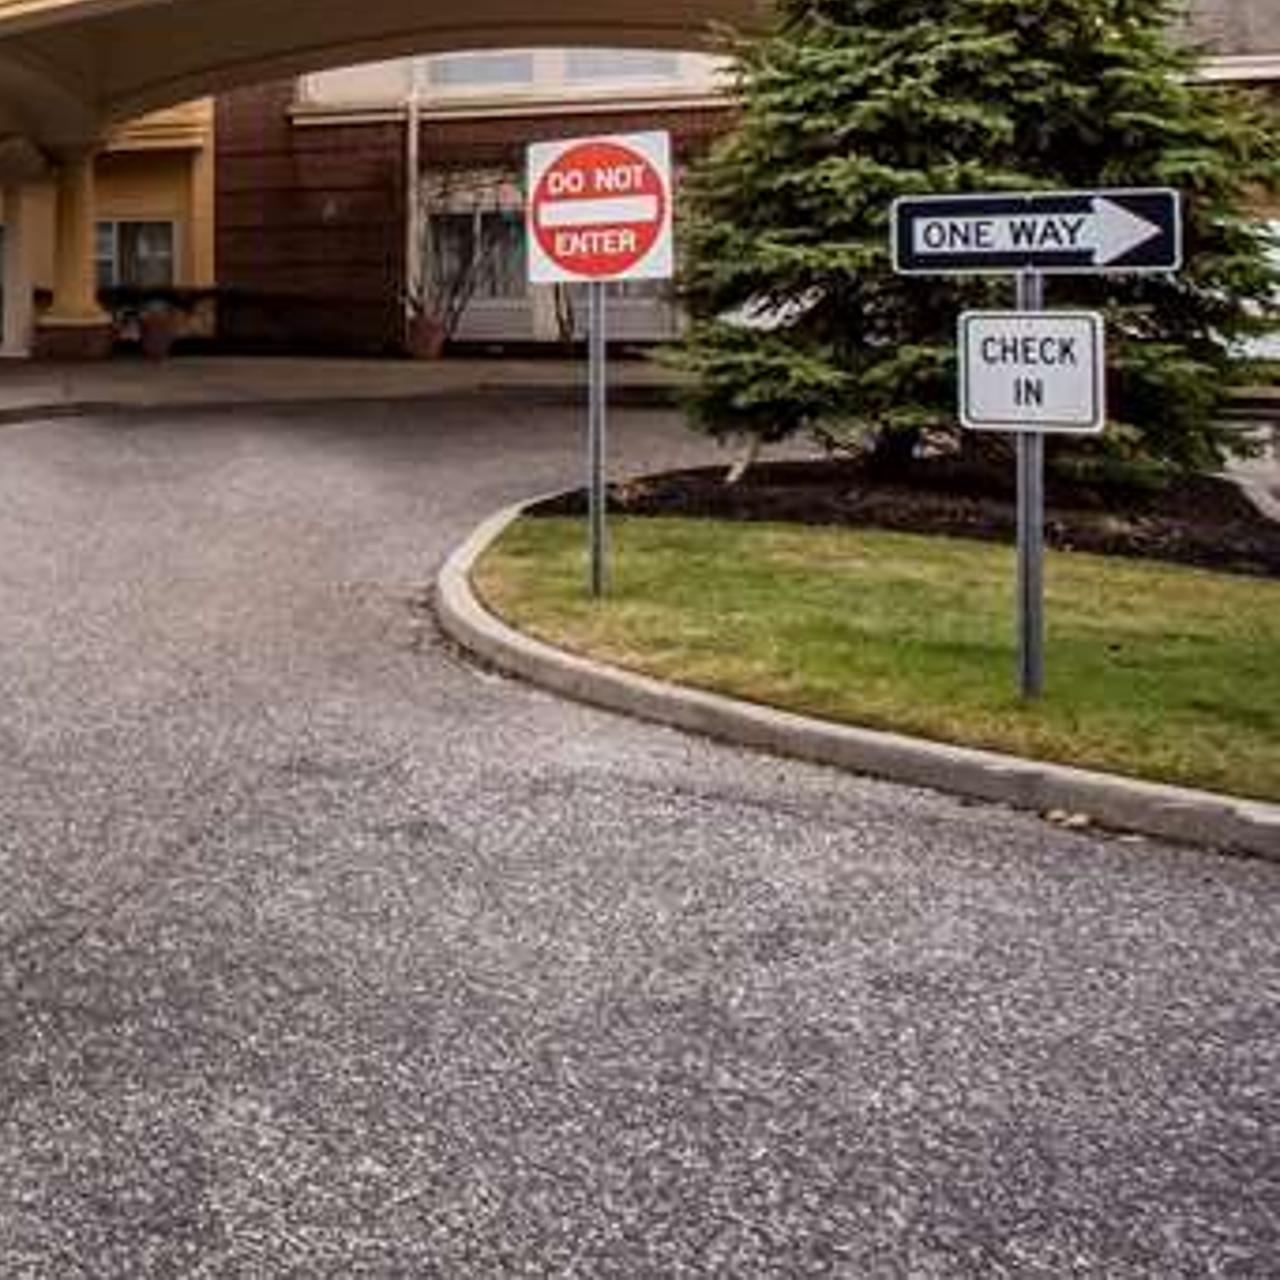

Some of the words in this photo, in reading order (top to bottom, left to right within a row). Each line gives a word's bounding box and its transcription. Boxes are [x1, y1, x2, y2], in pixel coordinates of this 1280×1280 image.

[547, 169, 585, 194] DO
[595, 164, 647, 191] NOT
[555, 229, 636, 255] ENTER
[923, 221, 994, 248] ONE
[1009, 217, 1086, 246] WAY
[981, 336, 1077, 365] CHECK
[1013, 378, 1044, 406] IN
